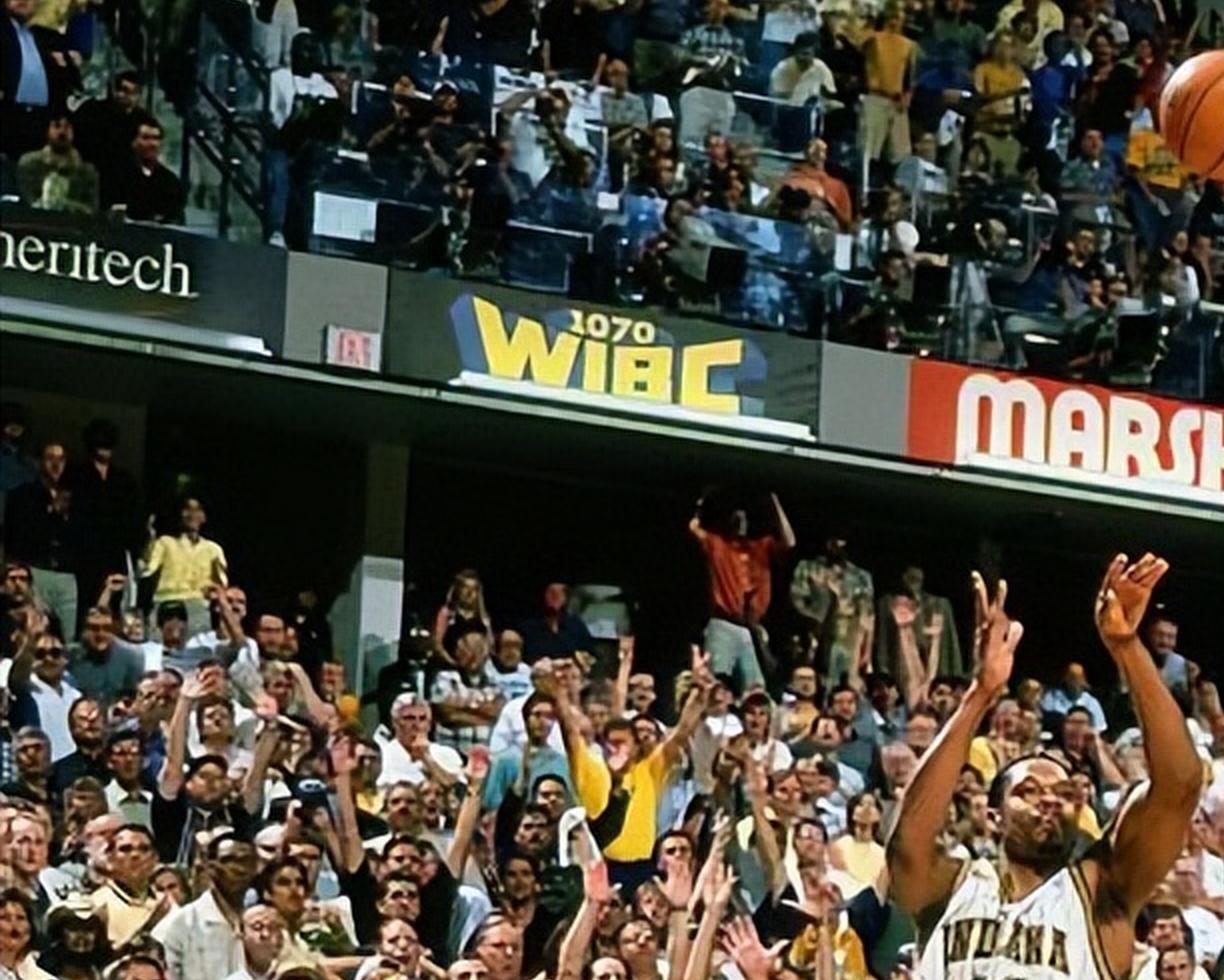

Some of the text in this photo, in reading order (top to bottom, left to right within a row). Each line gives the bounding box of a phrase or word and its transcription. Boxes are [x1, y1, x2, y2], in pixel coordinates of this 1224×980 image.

[473, 296, 743, 415] WIBC
[570, 309, 656, 344] 1070
[941, 917, 1070, 977] INDANA
